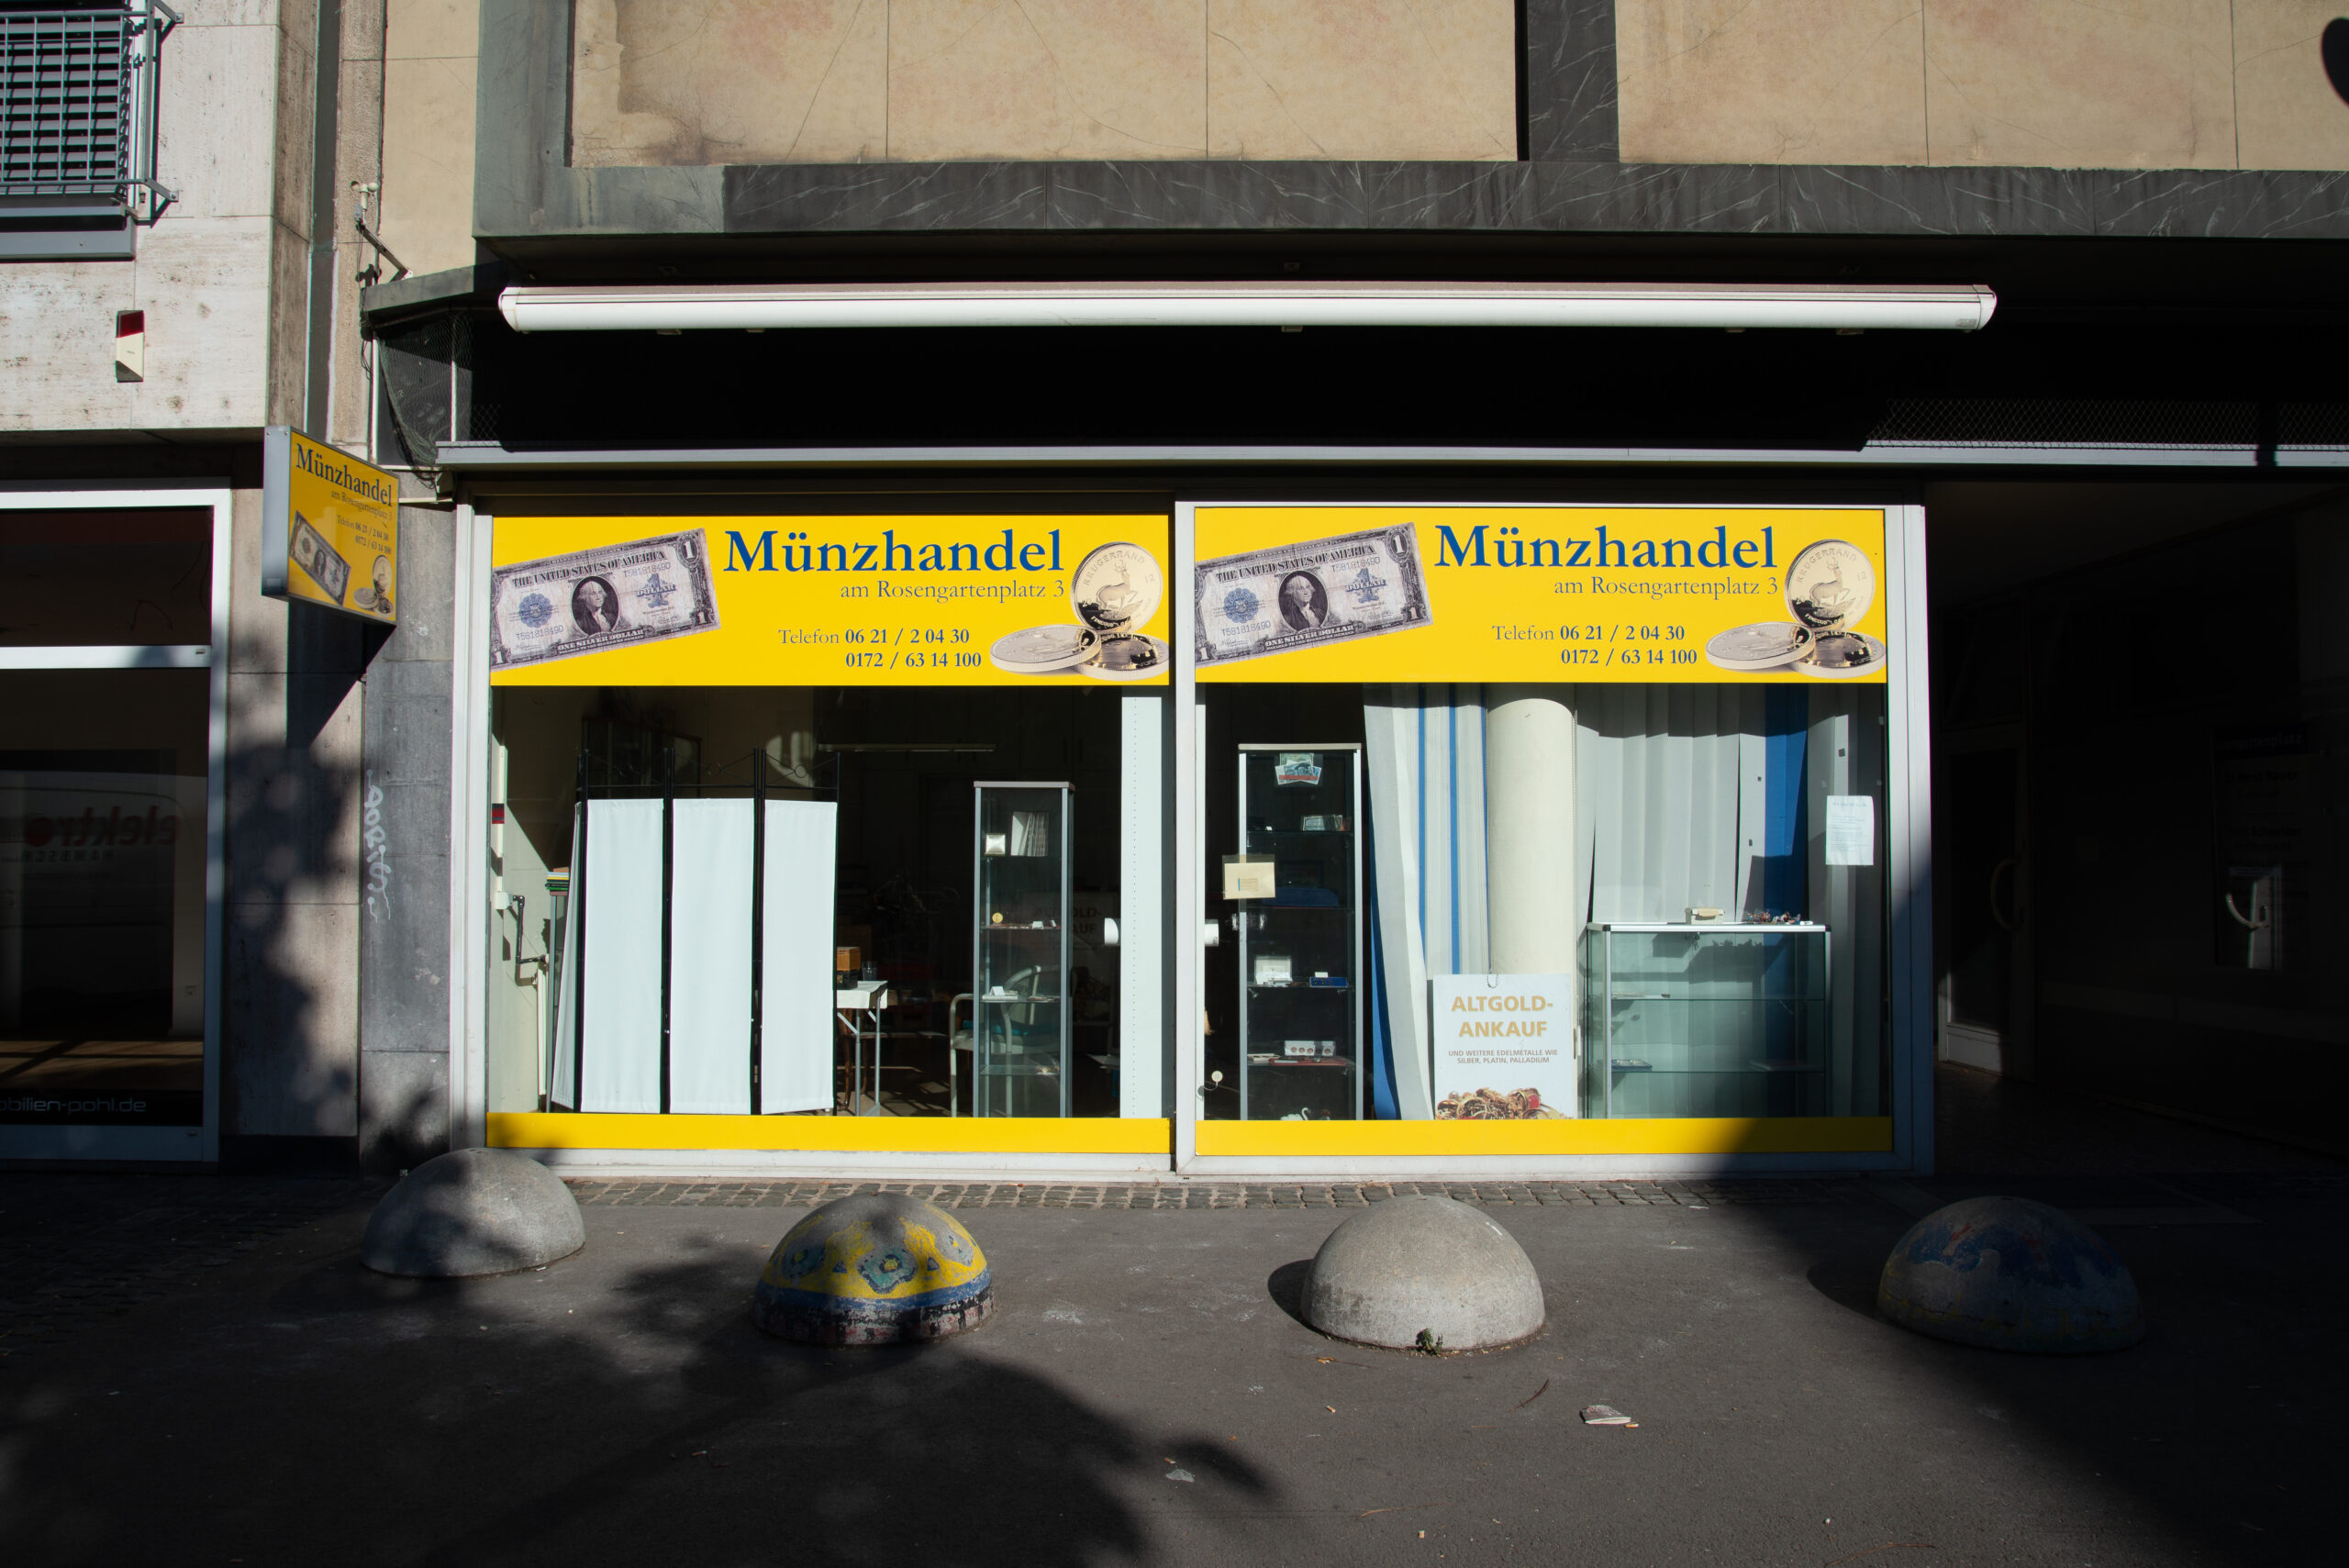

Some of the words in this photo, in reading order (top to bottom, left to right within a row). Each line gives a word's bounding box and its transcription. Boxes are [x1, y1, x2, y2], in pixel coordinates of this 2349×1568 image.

[295, 443, 393, 507] Münzhandel
[684, 540, 695, 559] 1
[723, 528, 1063, 573] Münzhandel
[1393, 535, 1405, 553] 1
[1435, 524, 1777, 569] Münzhandel
[513, 575, 532, 588] THE
[533, 568, 571, 586] UNITED
[571, 562, 607, 578] STATES
[607, 557, 621, 571] OF
[622, 550, 668, 566] AMERICA
[1083, 551, 1145, 585] KRUGERRAND
[1217, 570, 1238, 583] THE
[1239, 562, 1277, 580] UNITED
[1278, 555, 1314, 573] STATES
[1315, 552, 1329, 565] OF
[1329, 545, 1375, 562] AMERICA
[1797, 549, 1856, 583] KRUGERRAND
[841, 586, 868, 597] am
[878, 580, 1045, 603] Rosengartenplatz
[1054, 580, 1063, 597] 3
[1555, 583, 1583, 594] am
[1593, 576, 1759, 600] Rosengartenplatz
[1768, 577, 1777, 594] 3
[697, 612, 707, 625] 1
[1409, 606, 1419, 620] 1
[557, 639, 576, 651] ONE
[576, 634, 608, 648] SILVER
[609, 628, 645, 641] DOLLAR
[778, 629, 839, 643] Telefon
[845, 629, 863, 643] 06
[871, 629, 886, 643] 21
[895, 628, 903, 646] /
[910, 629, 919, 643] 2
[926, 629, 944, 643] 04
[951, 629, 969, 643] 30
[1265, 634, 1284, 647] ONE
[1285, 628, 1319, 644] SILVER
[1319, 624, 1355, 638] DOLLAR
[1492, 626, 1553, 639] Telefon
[1561, 626, 1579, 639] 06
[1586, 626, 1601, 639] 21
[1610, 625, 1619, 642] /
[1626, 626, 1634, 639] 2
[1641, 626, 1659, 639] 04
[1666, 626, 1685, 639] 30
[846, 653, 883, 667] 0172
[890, 652, 898, 670] /
[906, 653, 924, 667] 63
[932, 653, 948, 667] 14
[955, 653, 981, 667] 100
[1562, 650, 1598, 663] 0172
[1606, 649, 1614, 666] /
[1621, 650, 1640, 663] 63
[1649, 650, 1664, 663] 14
[1672, 650, 1697, 663] 100
[1451, 995, 1553, 1012] ALTGOLD-
[1458, 1021, 1547, 1038] ANKAUF
